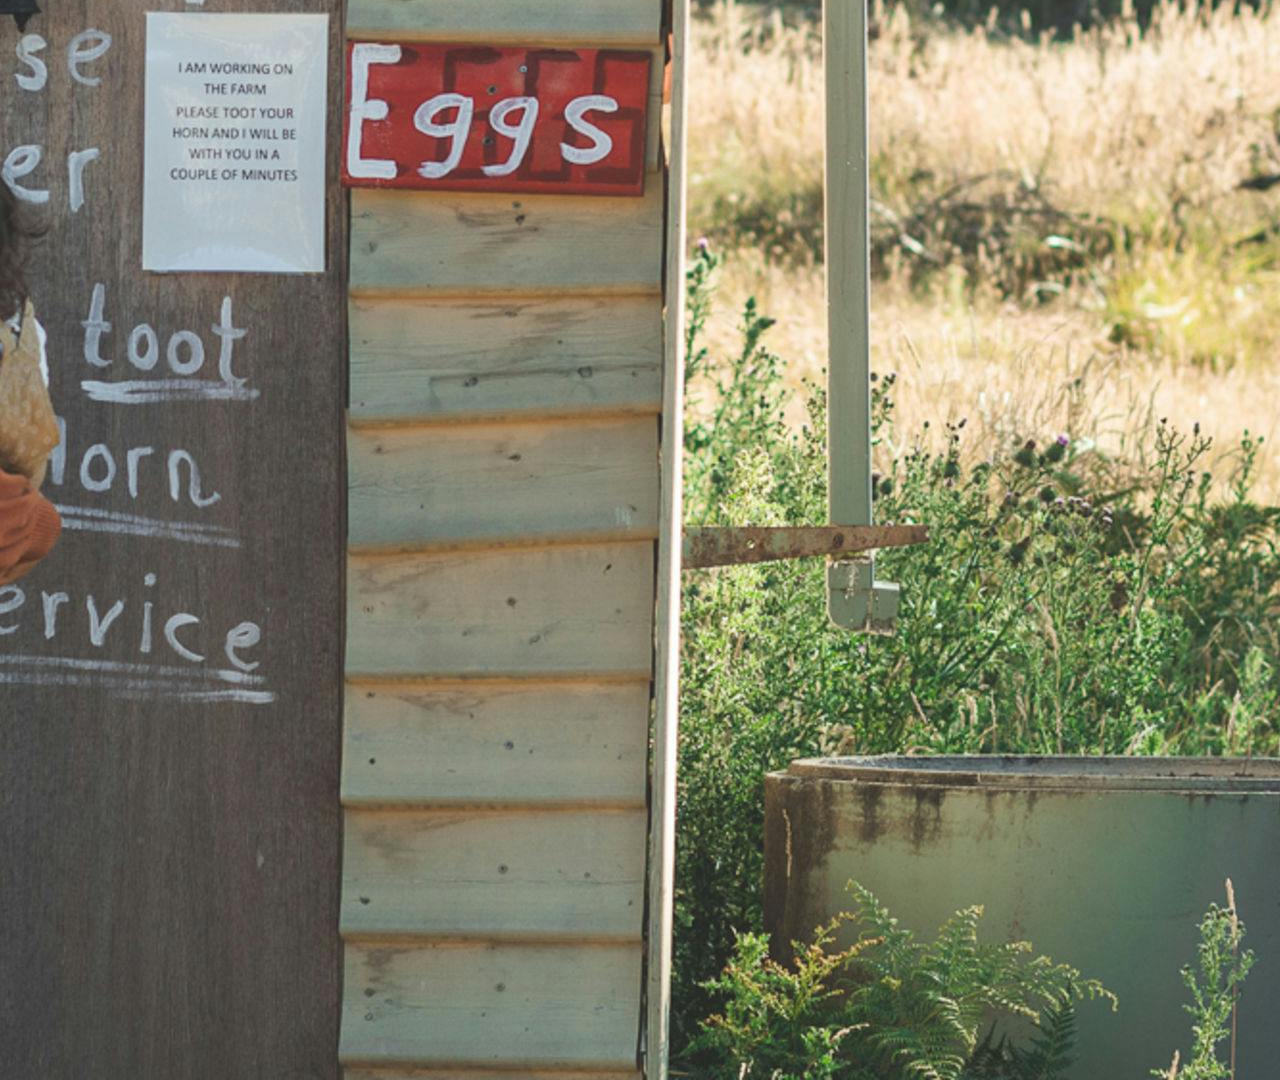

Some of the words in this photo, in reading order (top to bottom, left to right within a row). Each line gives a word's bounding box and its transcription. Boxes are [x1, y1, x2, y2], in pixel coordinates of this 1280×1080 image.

[185, 63, 206, 73] AM
[210, 63, 270, 74] WORKING
[273, 64, 293, 75] ON
[204, 83, 227, 95] THE
[231, 83, 266, 95] FARM
[176, 107, 218, 118] PLEASE
[223, 107, 256, 119] TOOT
[259, 108, 293, 119] YOUR
[347, 44, 618, 179] Eggs
[173, 127, 209, 138] HORN
[211, 128, 239, 139] AND
[249, 129, 278, 140] WILL
[282, 129, 296, 140] BE
[189, 148, 222, 159] WITH
[225, 148, 251, 160] YOU
[256, 149, 268, 159] IN
[271, 149, 280, 160] A
[170, 168, 218, 180] COUPLE
[221, 169, 238, 180] OF
[242, 169, 298, 181] MINUTES
[82, 283, 247, 387] toot
